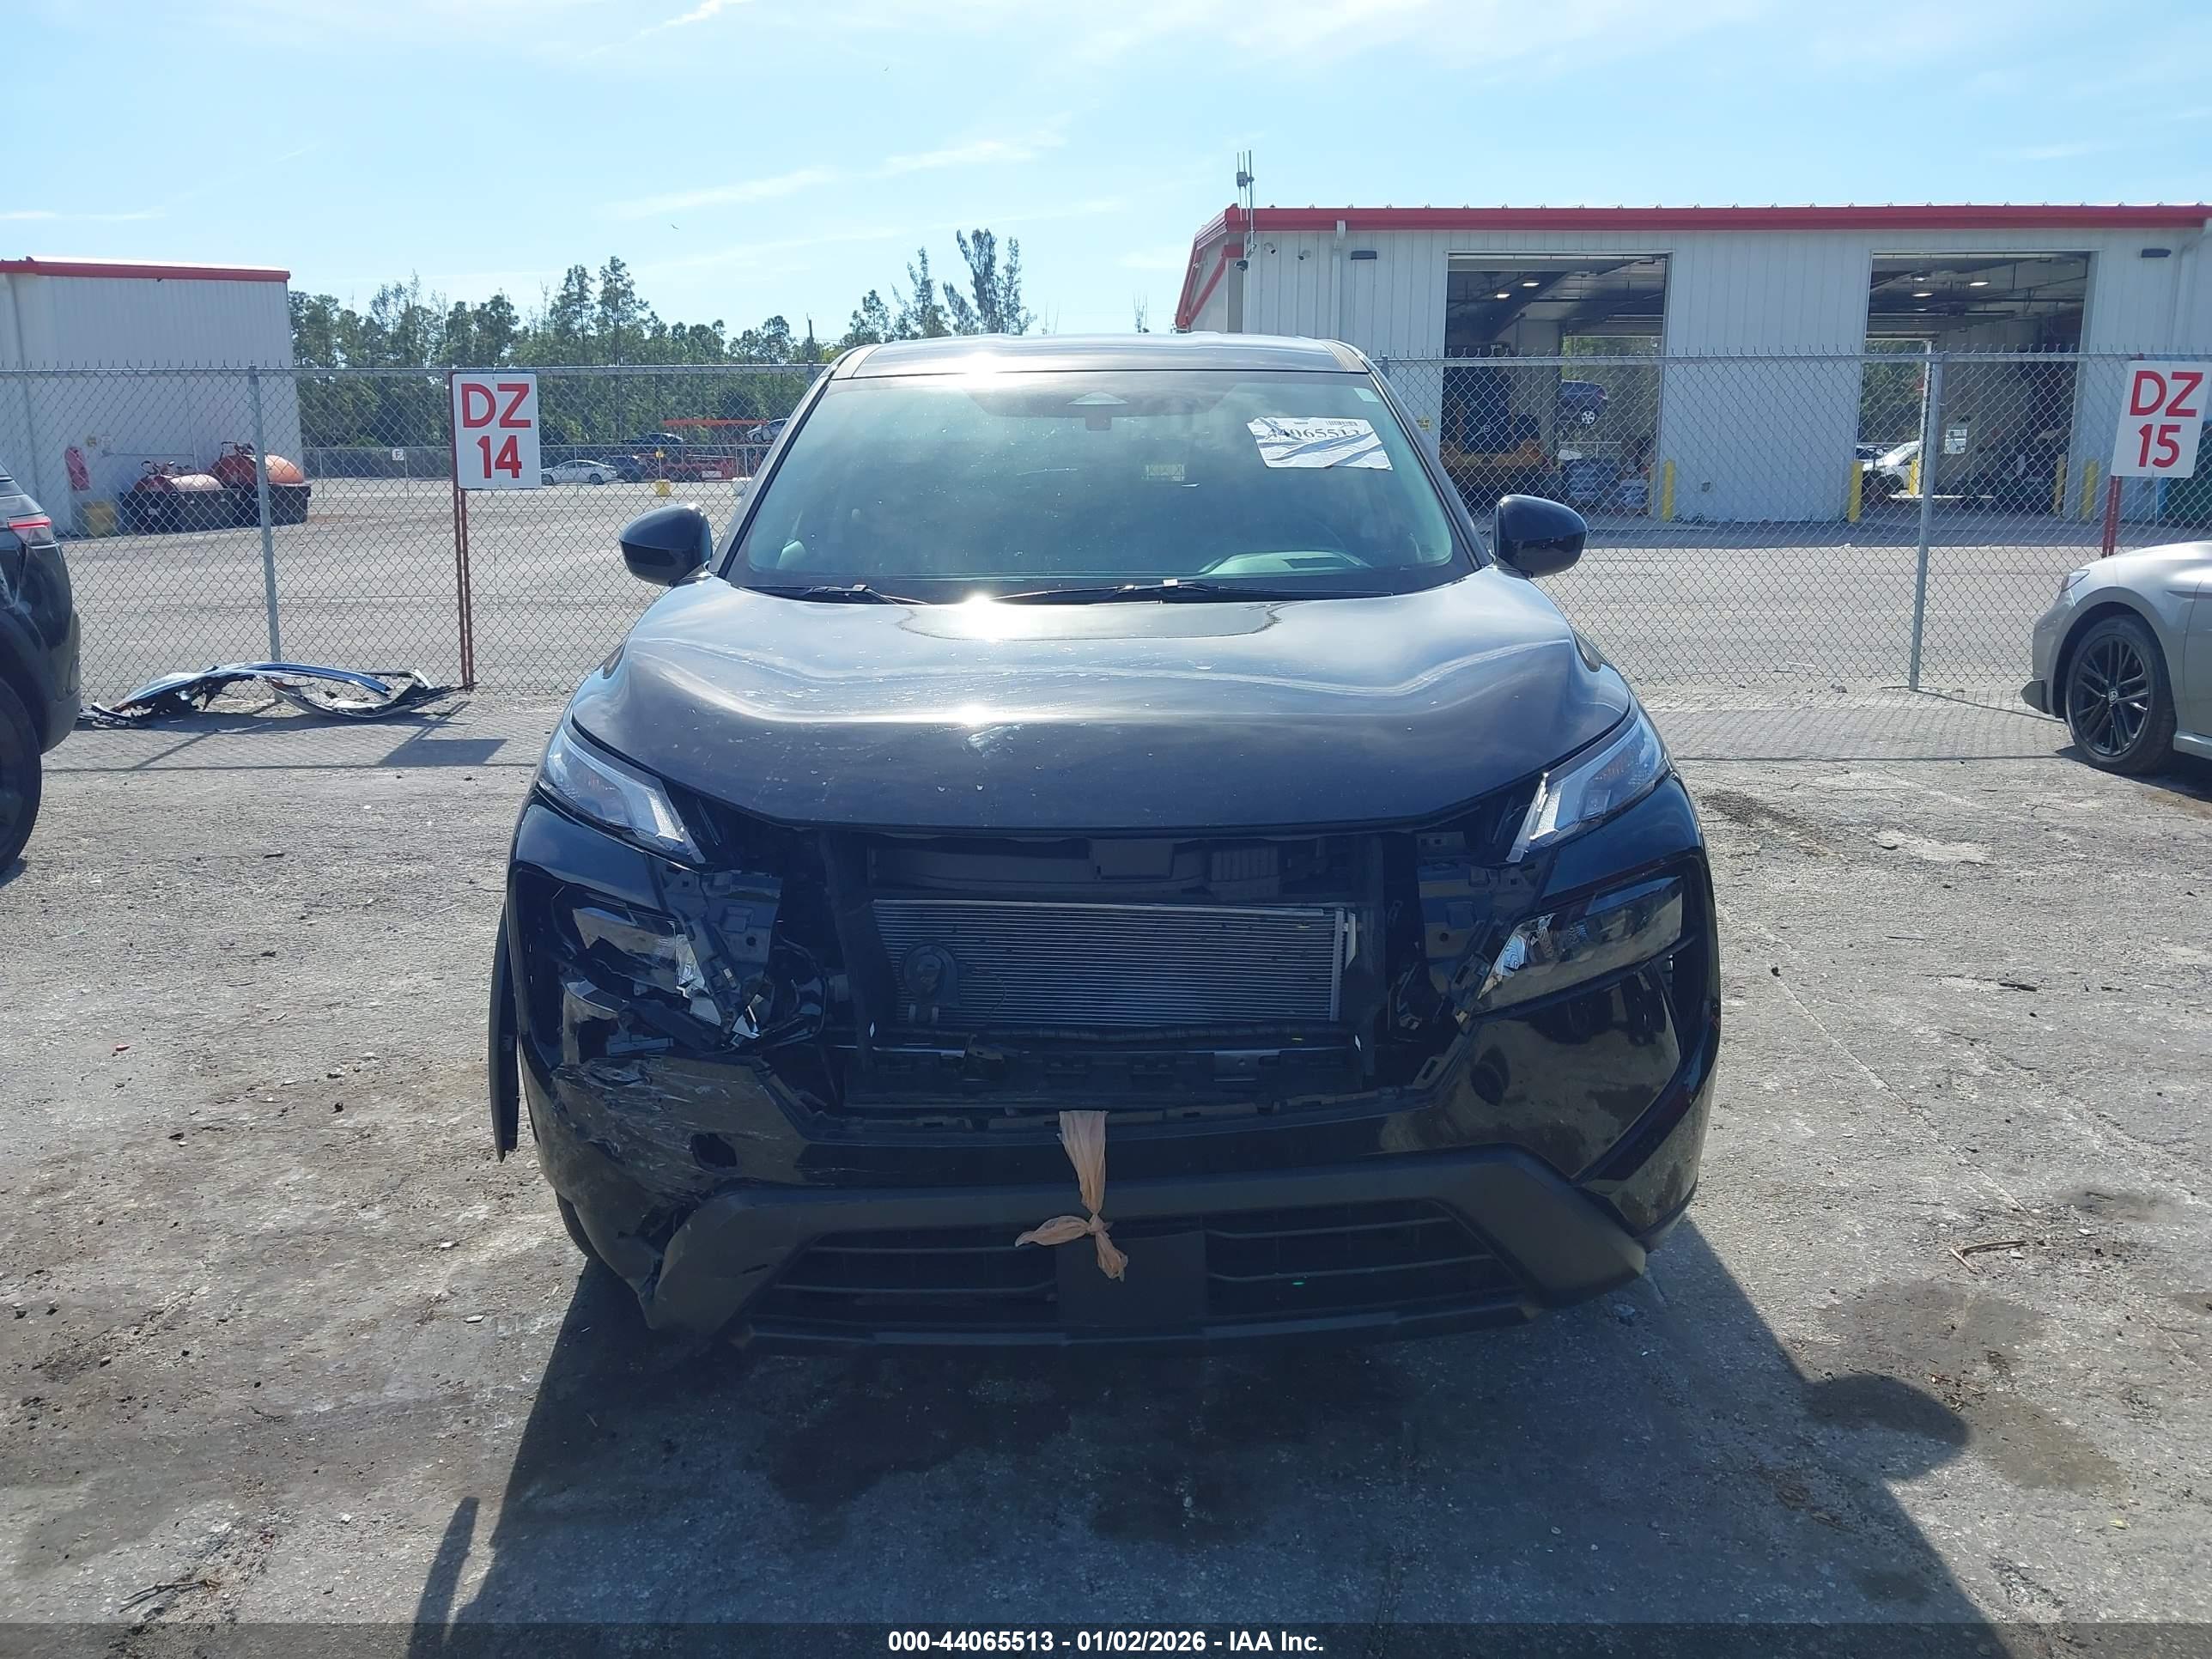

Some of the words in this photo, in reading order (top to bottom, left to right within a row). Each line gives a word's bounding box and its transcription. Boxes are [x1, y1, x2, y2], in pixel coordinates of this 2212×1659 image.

[461, 383, 532, 428] DZ
[2130, 370, 2203, 417] DZ
[477, 434, 522, 478] 14
[2138, 423, 2182, 468] 15
